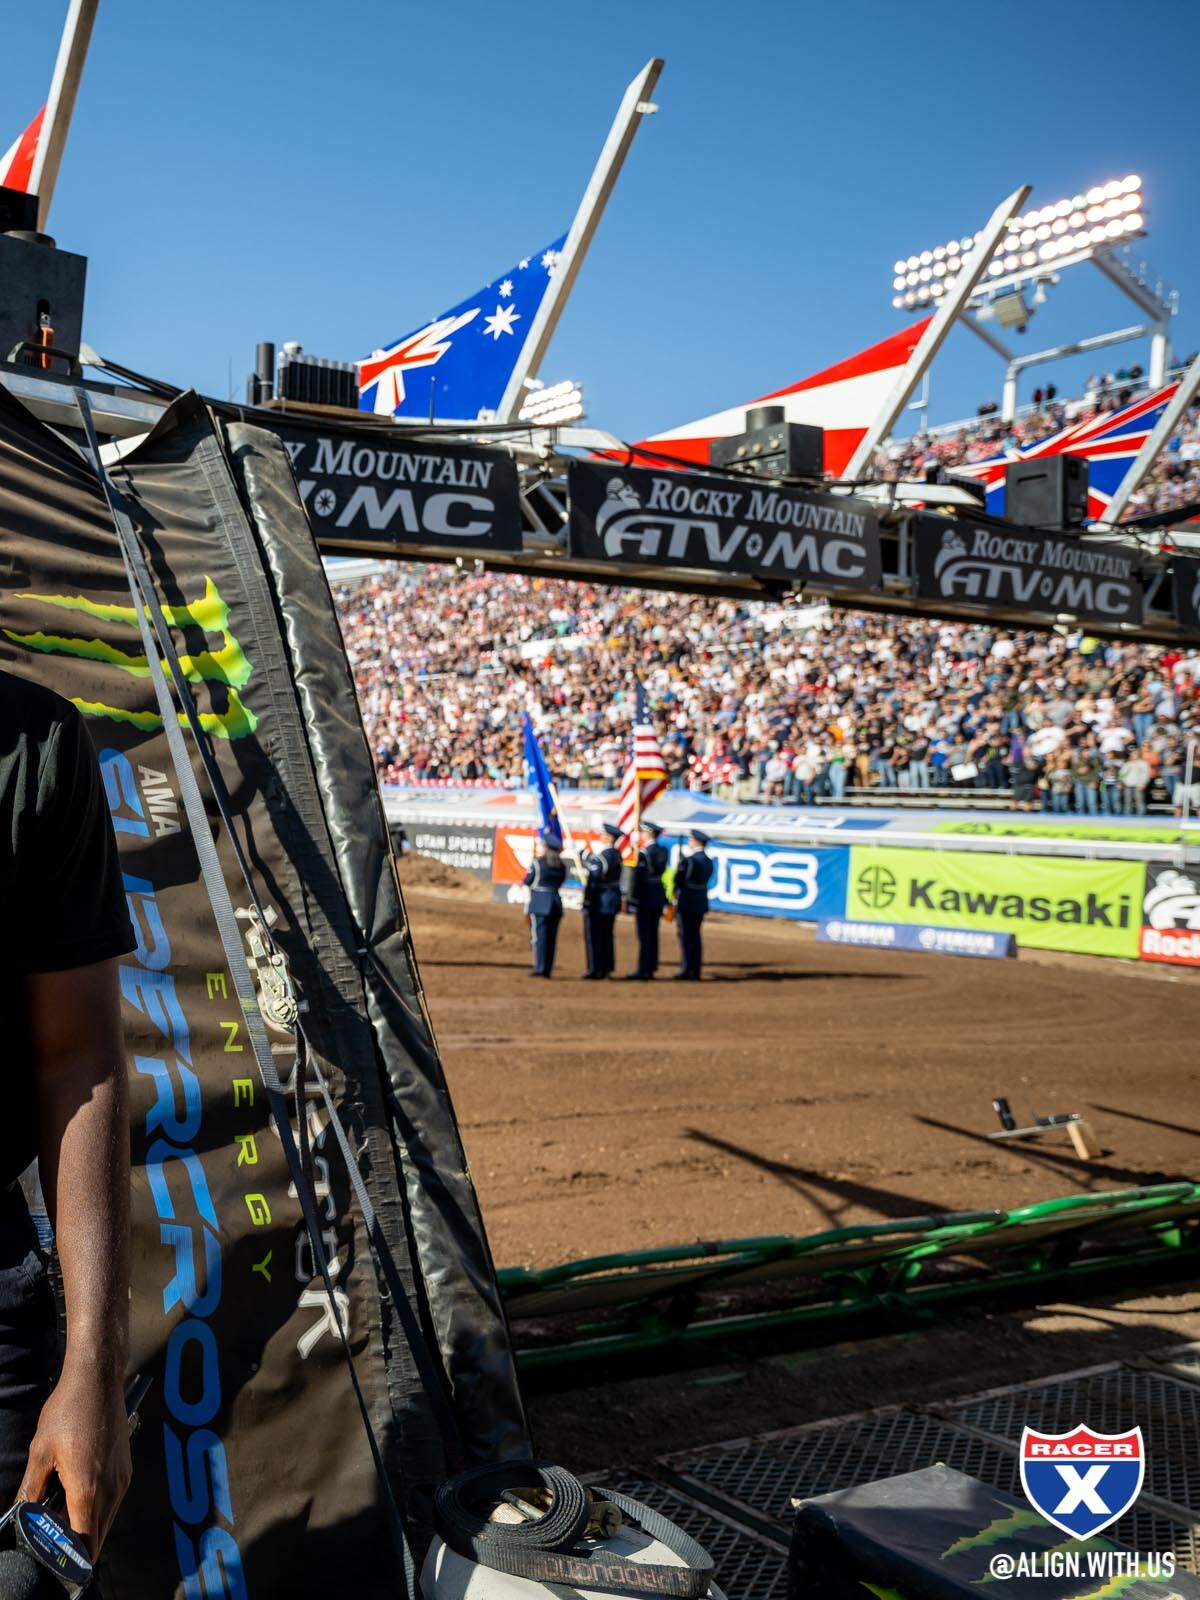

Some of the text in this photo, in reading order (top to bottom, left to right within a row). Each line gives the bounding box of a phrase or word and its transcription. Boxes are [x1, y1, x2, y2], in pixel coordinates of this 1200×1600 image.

[314, 438, 494, 489] MOUNTAIN
[645, 477, 866, 539] ROCKY MOUNTAIN
[972, 529, 1131, 580] ROCKY MOUNTAIN
[137, 763, 182, 838] AMA
[415, 833, 493, 854] UTAH SPORTS
[909, 878, 1131, 929] Kawasaki
[1142, 929, 1200, 959] Rock
[205, 972, 273, 1284] ENERGY
[36, 1515, 61, 1541] LIVE
